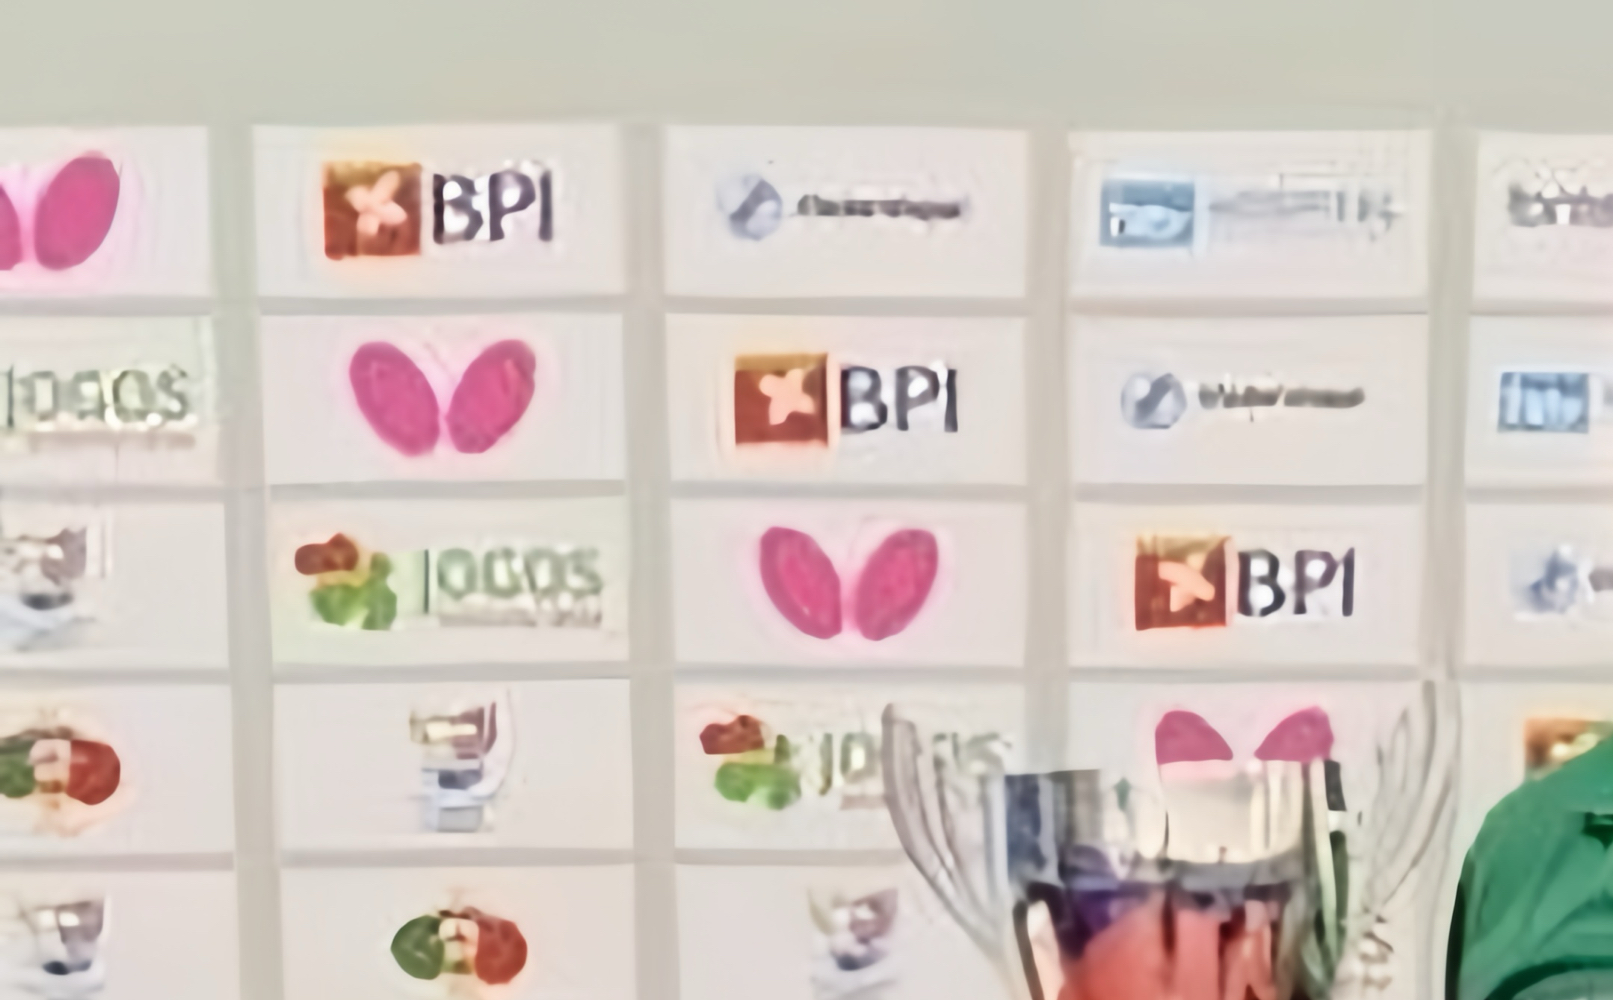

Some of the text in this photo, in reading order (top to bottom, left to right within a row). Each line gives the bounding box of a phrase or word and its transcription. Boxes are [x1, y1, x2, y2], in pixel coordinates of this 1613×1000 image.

[431, 167, 555, 245] BPI
[838, 365, 958, 433] BPI
[1236, 547, 1356, 617] BPI
